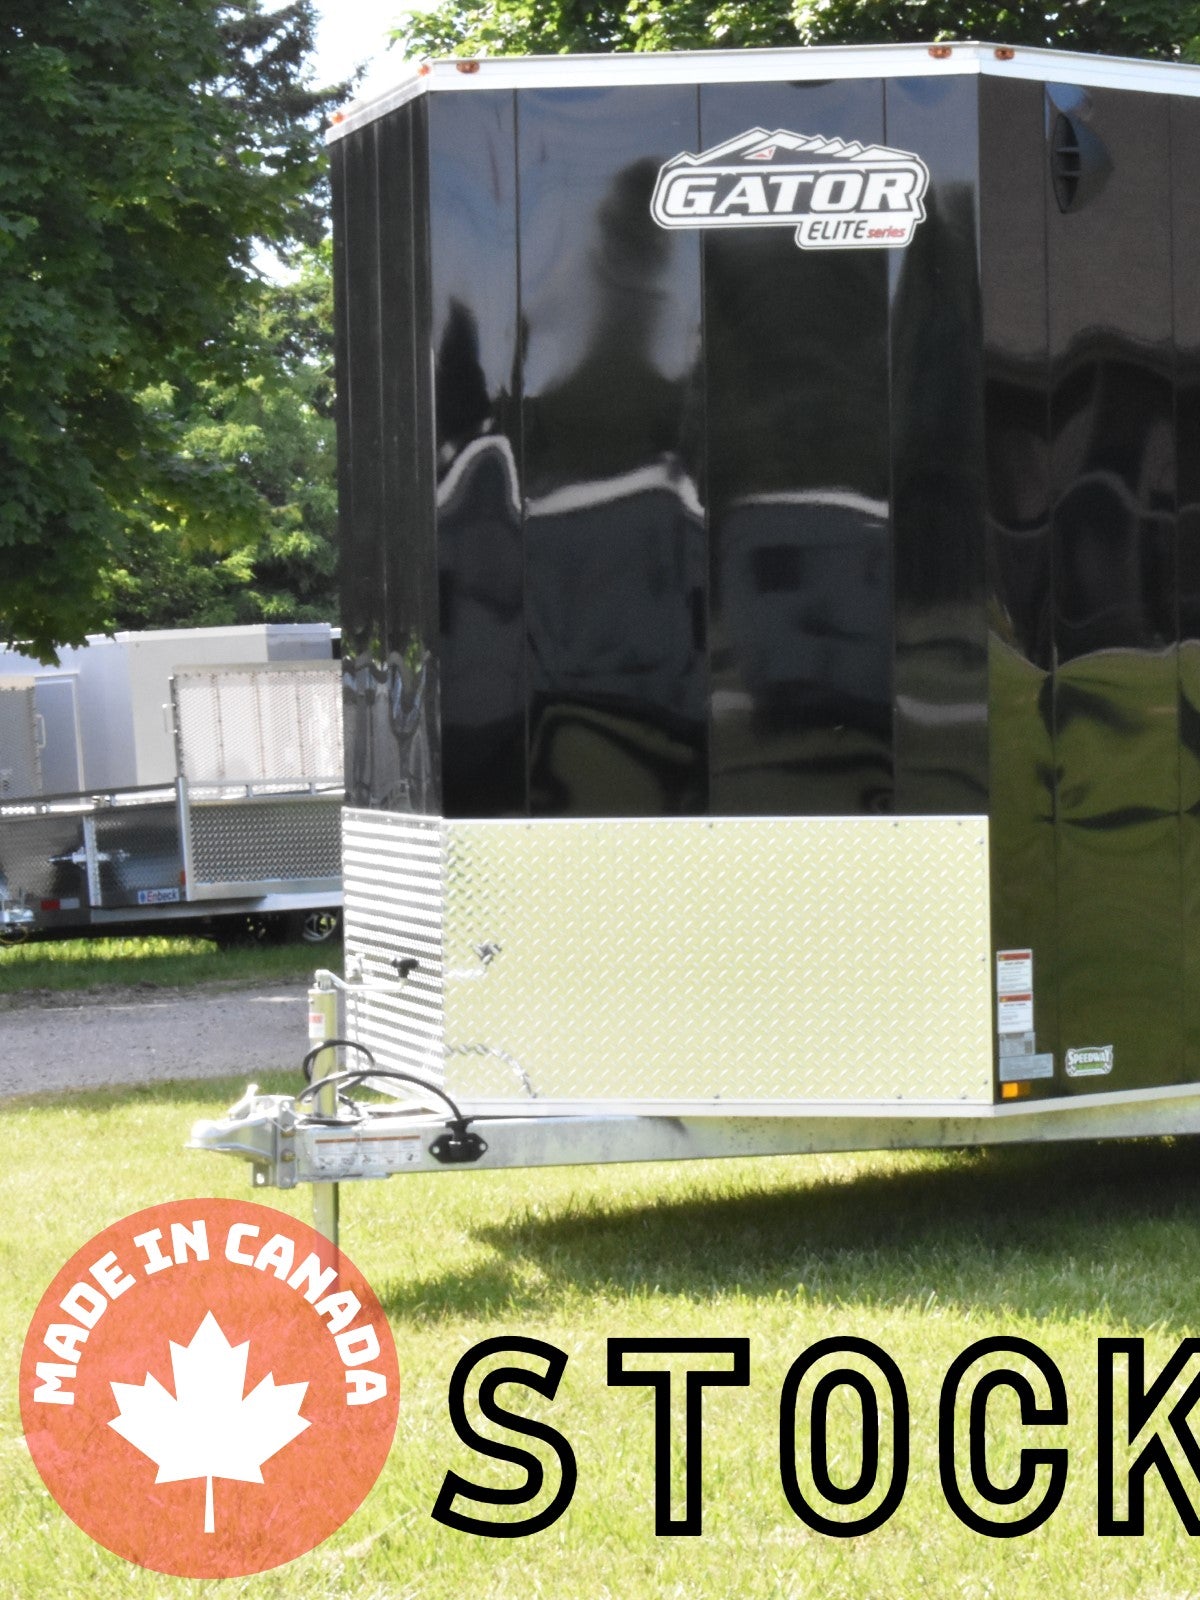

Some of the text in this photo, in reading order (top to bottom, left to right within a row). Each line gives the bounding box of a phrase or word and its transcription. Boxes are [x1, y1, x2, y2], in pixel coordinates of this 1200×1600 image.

[665, 171, 916, 215] GATOR
[808, 220, 906, 240] ELITE series
